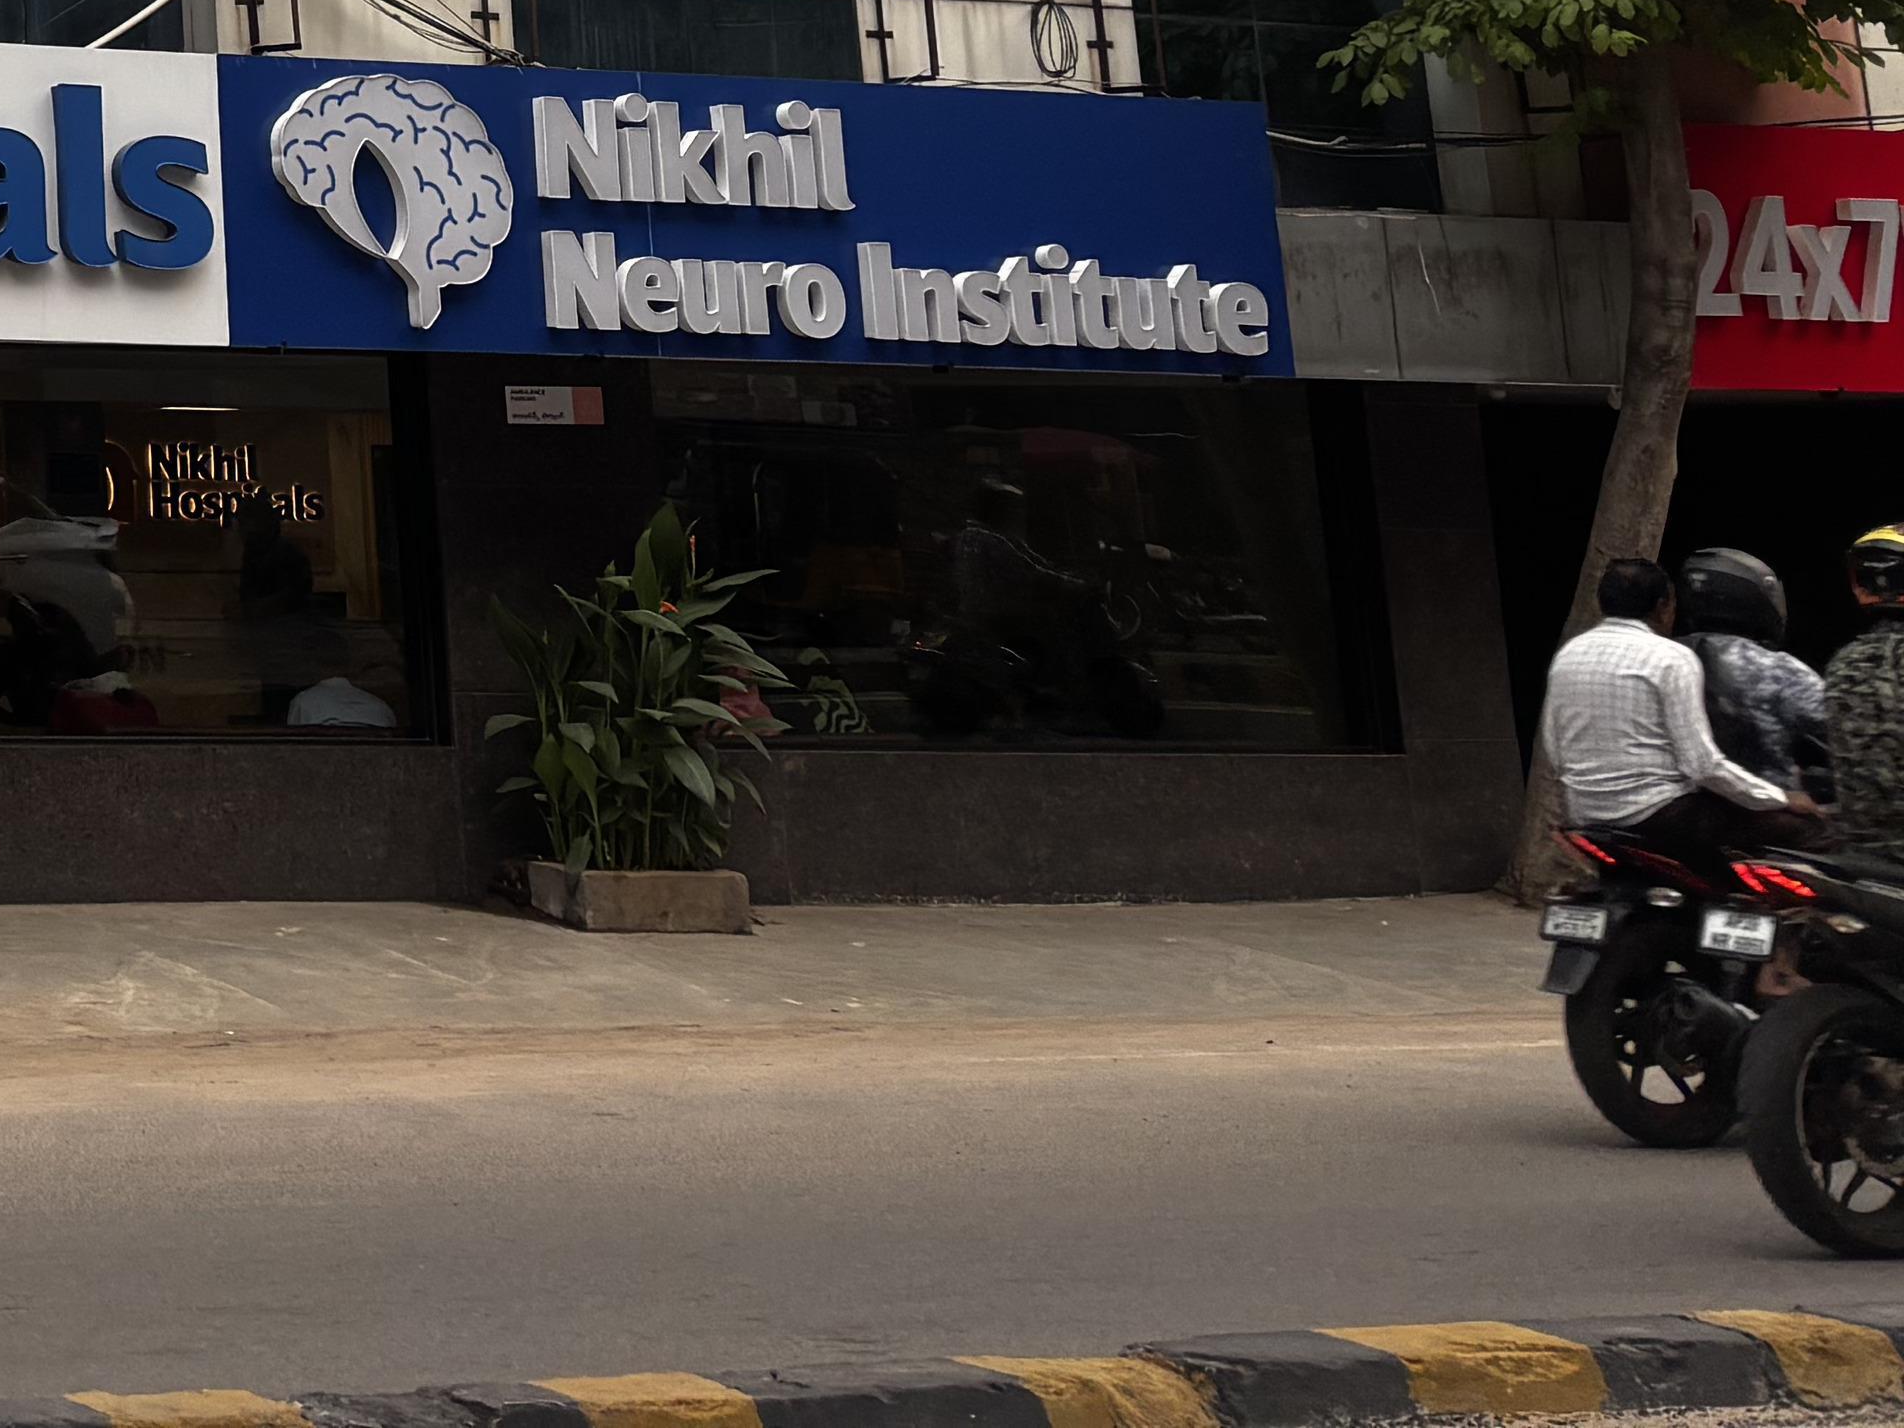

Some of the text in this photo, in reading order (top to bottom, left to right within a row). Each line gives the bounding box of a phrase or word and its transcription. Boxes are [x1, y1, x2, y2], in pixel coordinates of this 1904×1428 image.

[532, 91, 857, 212] Nikhil
[540, 228, 1270, 358] Neuro Institute
[1690, 187, 1900, 323] 24x7
[146, 438, 258, 483] Nikhil
[147, 479, 325, 528] Hospals
